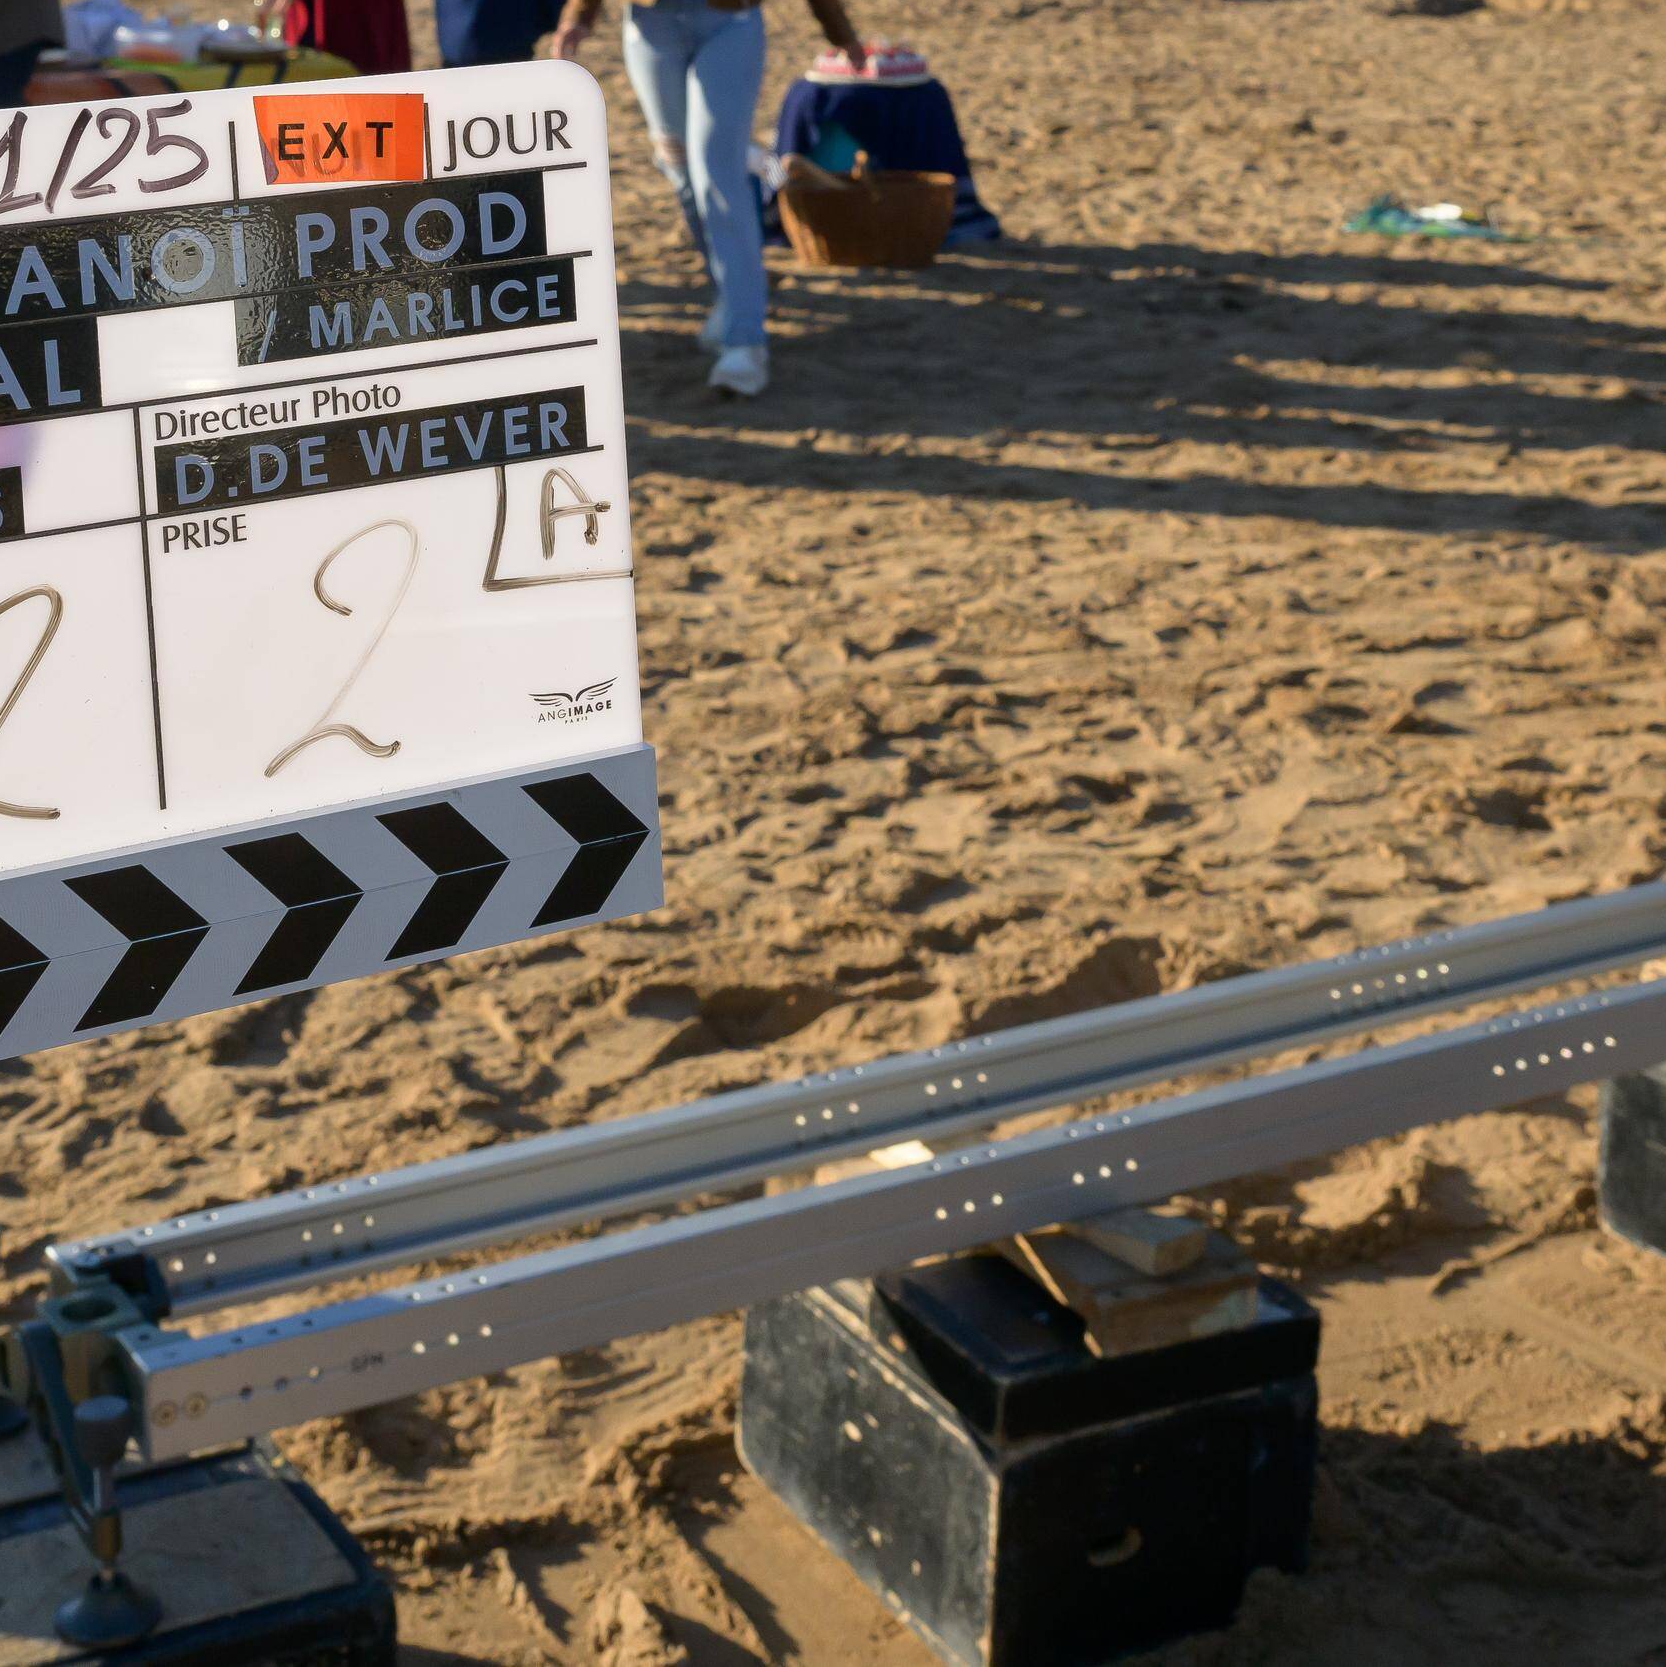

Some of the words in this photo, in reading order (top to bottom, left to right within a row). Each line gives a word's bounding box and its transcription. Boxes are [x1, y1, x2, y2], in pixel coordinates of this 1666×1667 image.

[277, 121, 394, 161] EXT
[443, 109, 573, 172] JOUR
[295, 191, 527, 279] PROD
[308, 274, 561, 349] MARLICE
[154, 398, 301, 441] Directeur
[312, 383, 401, 419] Photo
[357, 402, 571, 476] WEVER
[162, 513, 248, 554] PRISE
[263, 518, 421, 778] 2
[537, 699, 612, 724] ANGIMAGE
